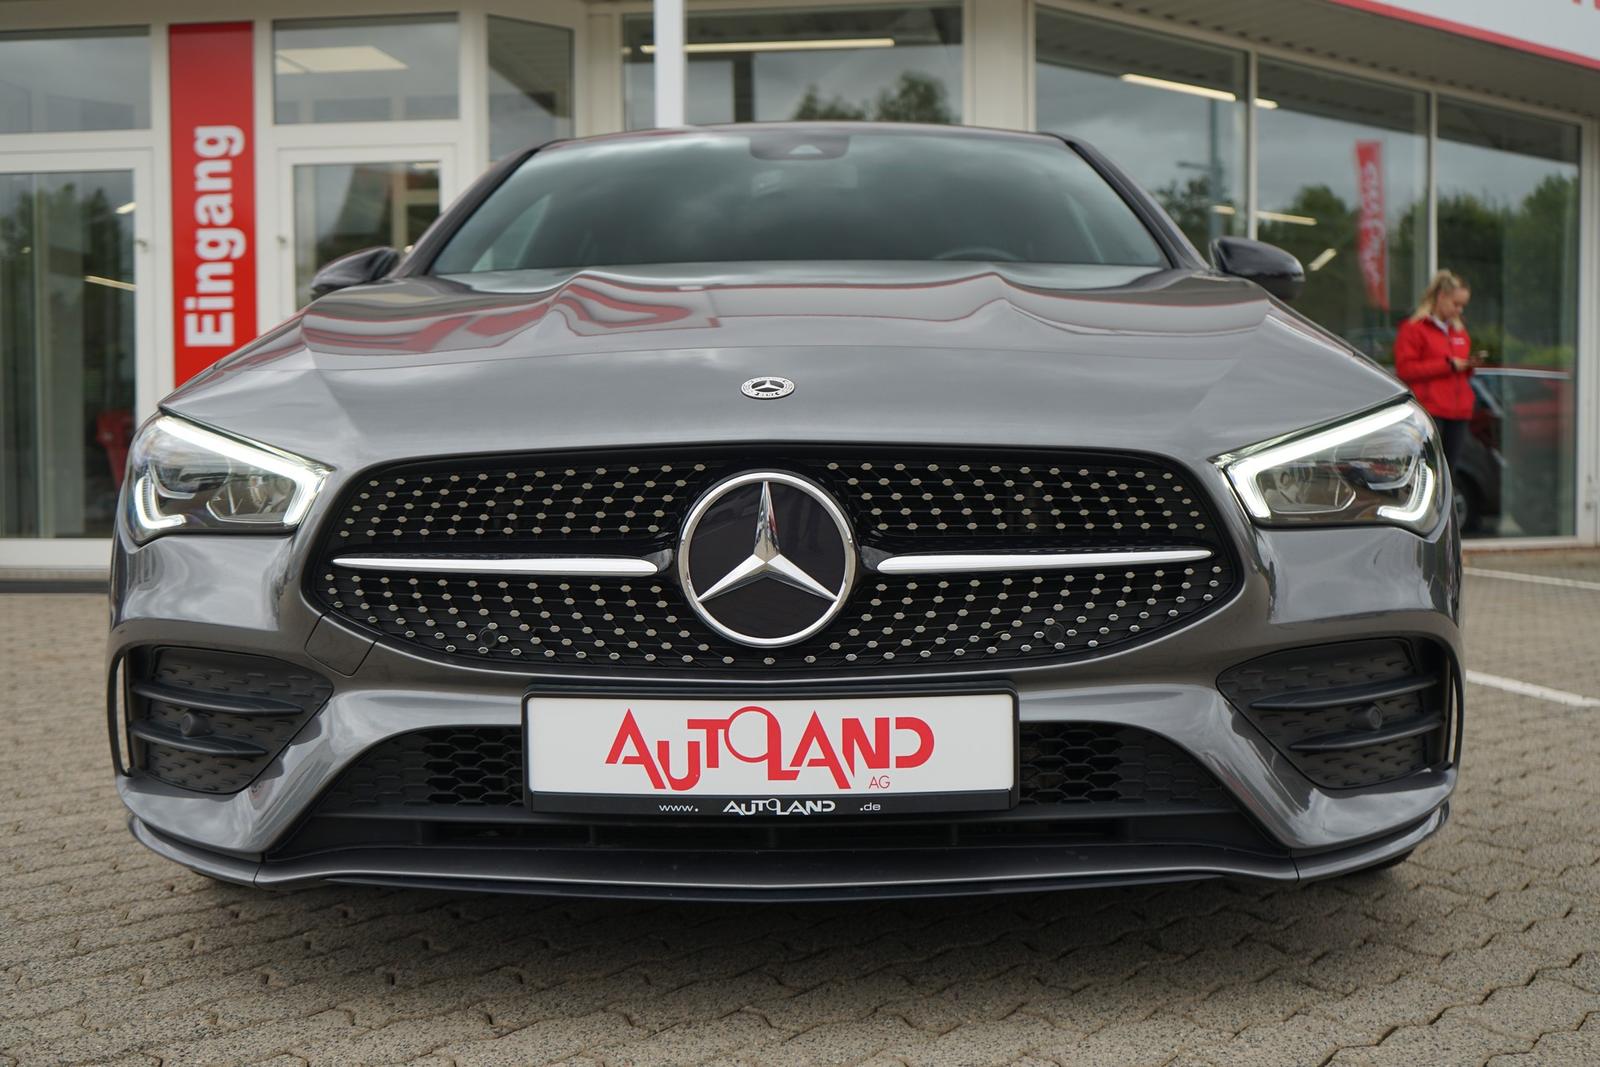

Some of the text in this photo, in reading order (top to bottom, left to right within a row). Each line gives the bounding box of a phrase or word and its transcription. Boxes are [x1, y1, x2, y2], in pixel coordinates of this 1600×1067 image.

[184, 125, 247, 347] Eingang
[605, 706, 935, 791] AUTOLAND
[659, 798, 881, 815] www. AUTOLAND .de
[868, 775, 891, 789] AG
